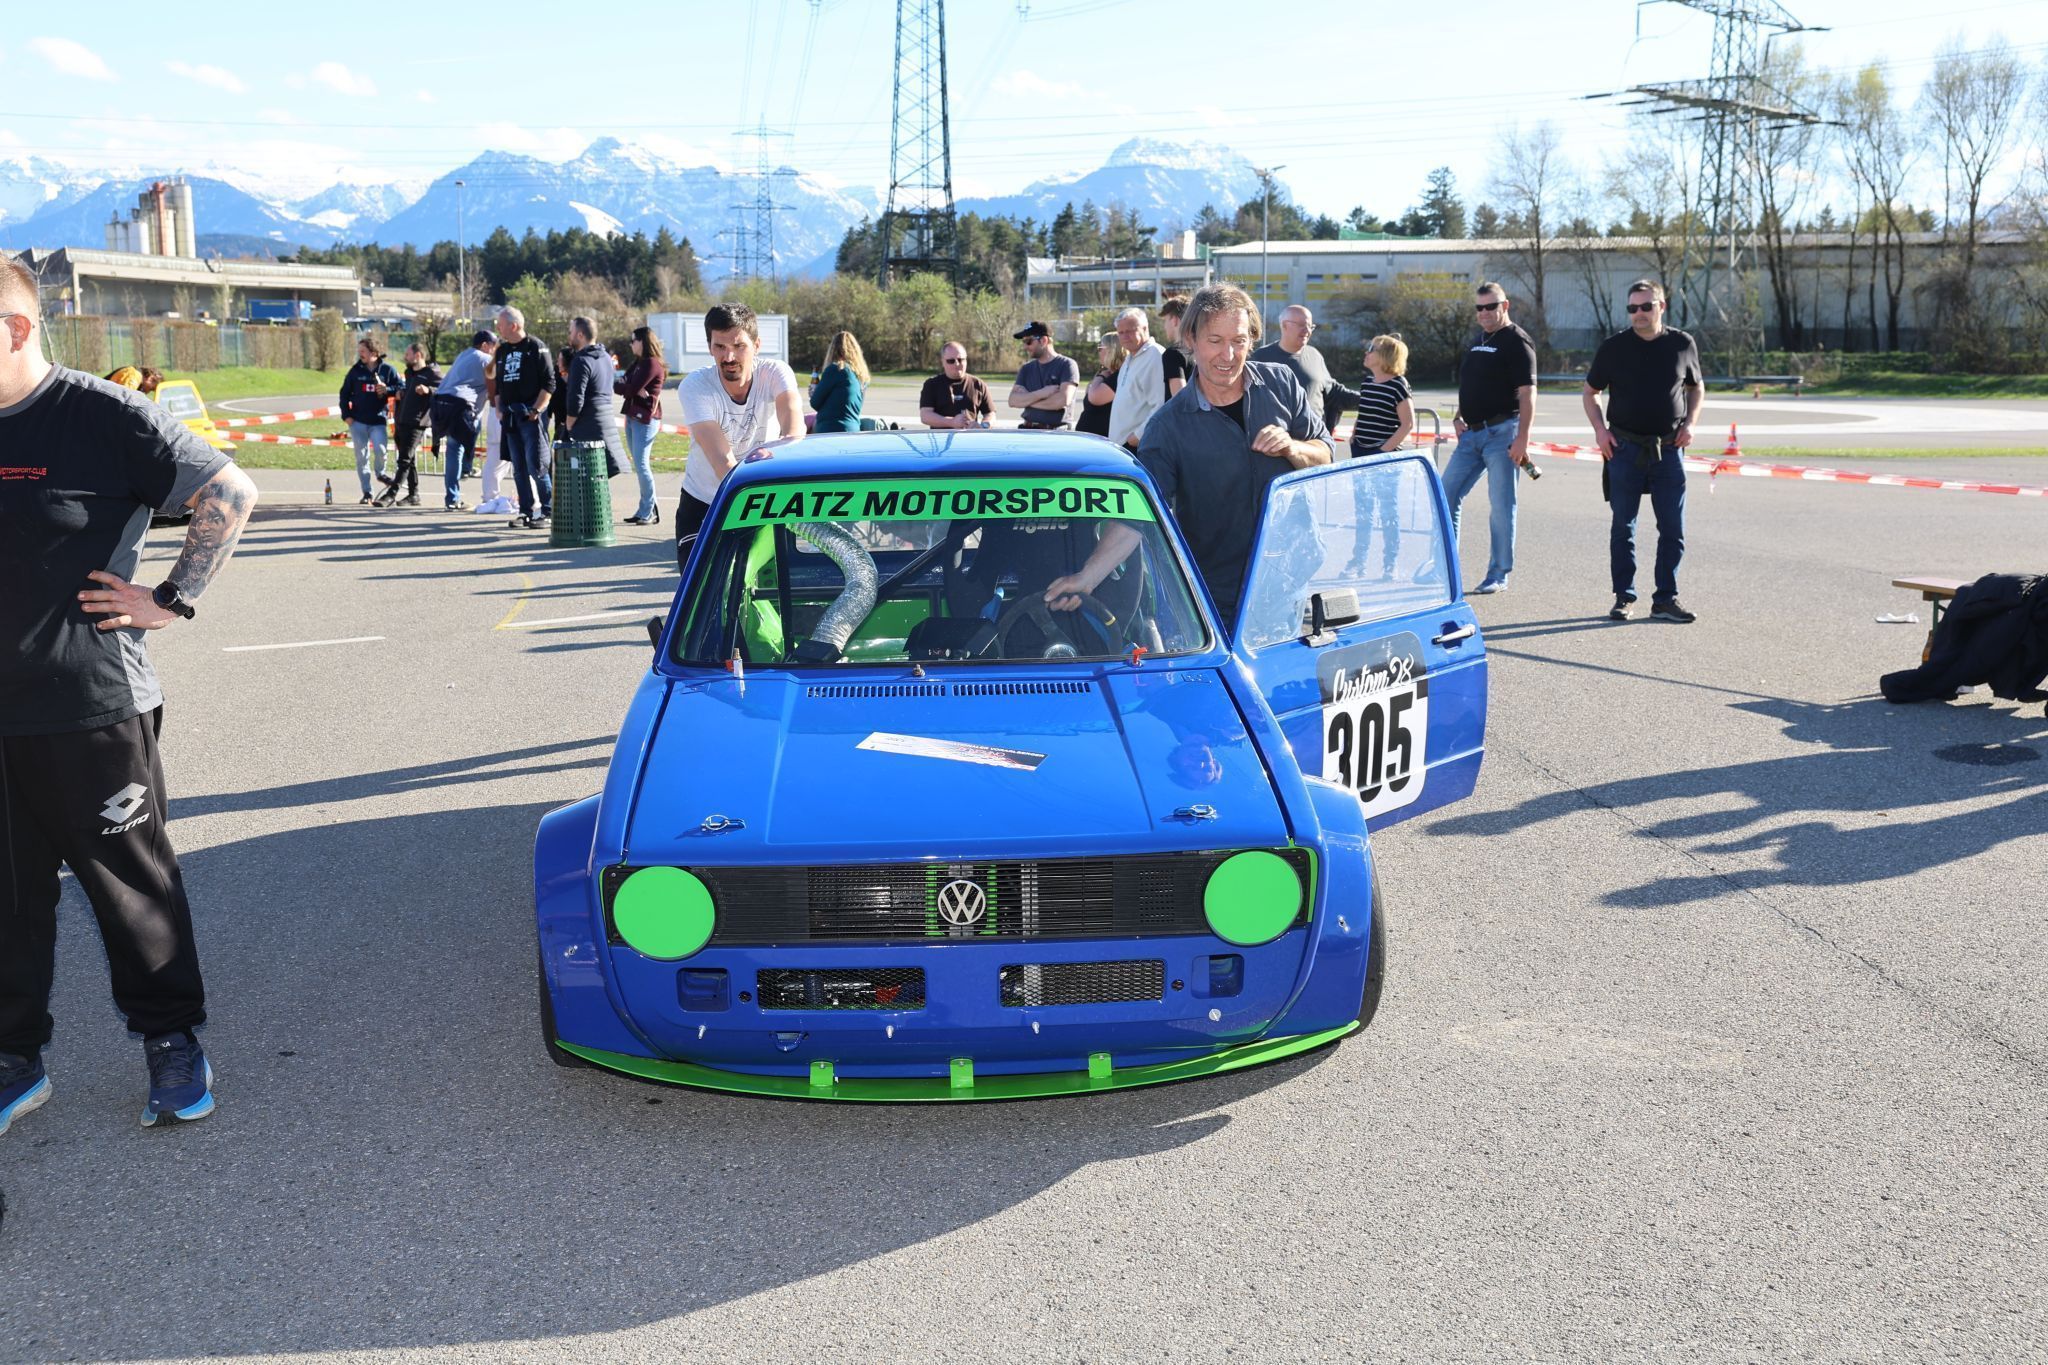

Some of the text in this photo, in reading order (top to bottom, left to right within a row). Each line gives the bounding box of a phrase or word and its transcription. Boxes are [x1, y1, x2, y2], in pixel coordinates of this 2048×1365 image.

[739, 487, 1130, 521] FLATZ MOTORSPORT
[1333, 652, 1415, 705] Custom 28
[1328, 691, 1414, 803] 305
[101, 812, 150, 835] LOTTO
[938, 880, 986, 926] VW
